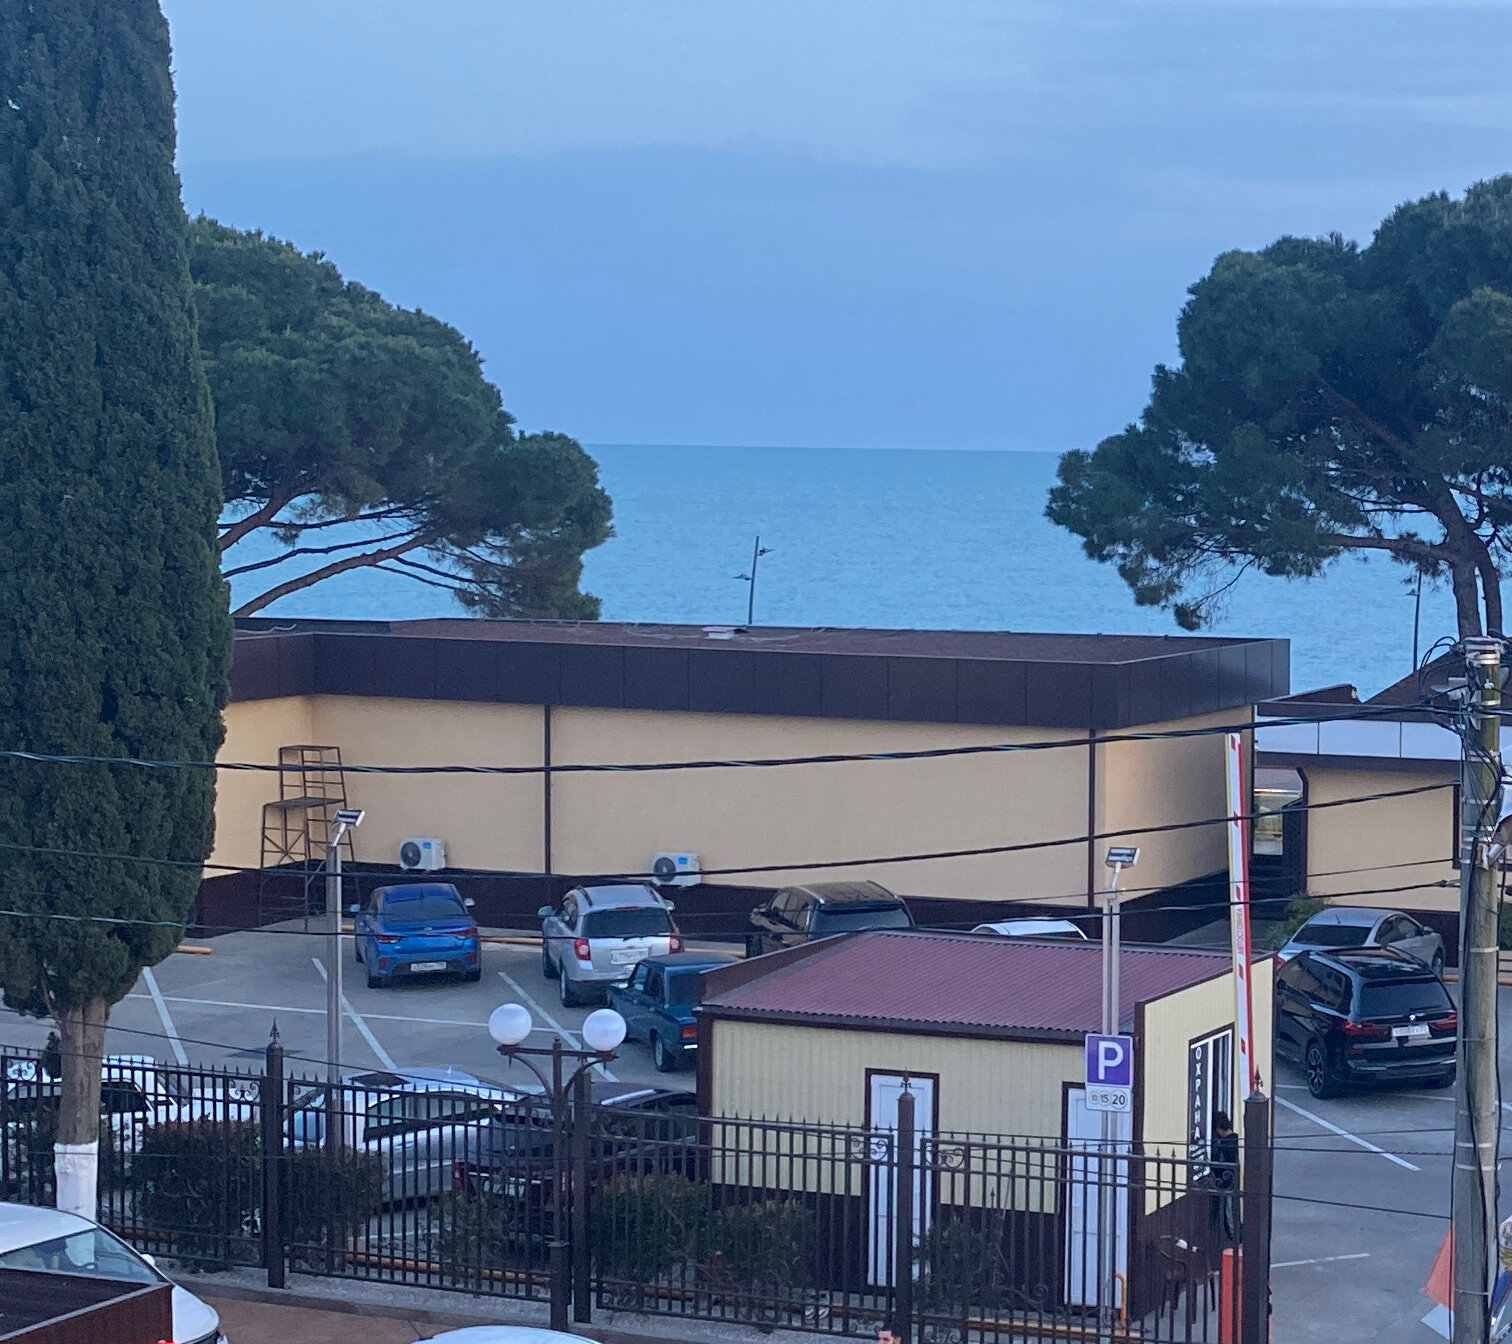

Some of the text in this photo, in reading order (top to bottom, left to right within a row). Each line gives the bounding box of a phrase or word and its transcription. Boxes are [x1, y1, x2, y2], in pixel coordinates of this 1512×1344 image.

[1098, 1041, 1124, 1080] P
[1111, 1094, 1126, 1106] 20
[1194, 1046, 1202, 1140] ОХРАНА
